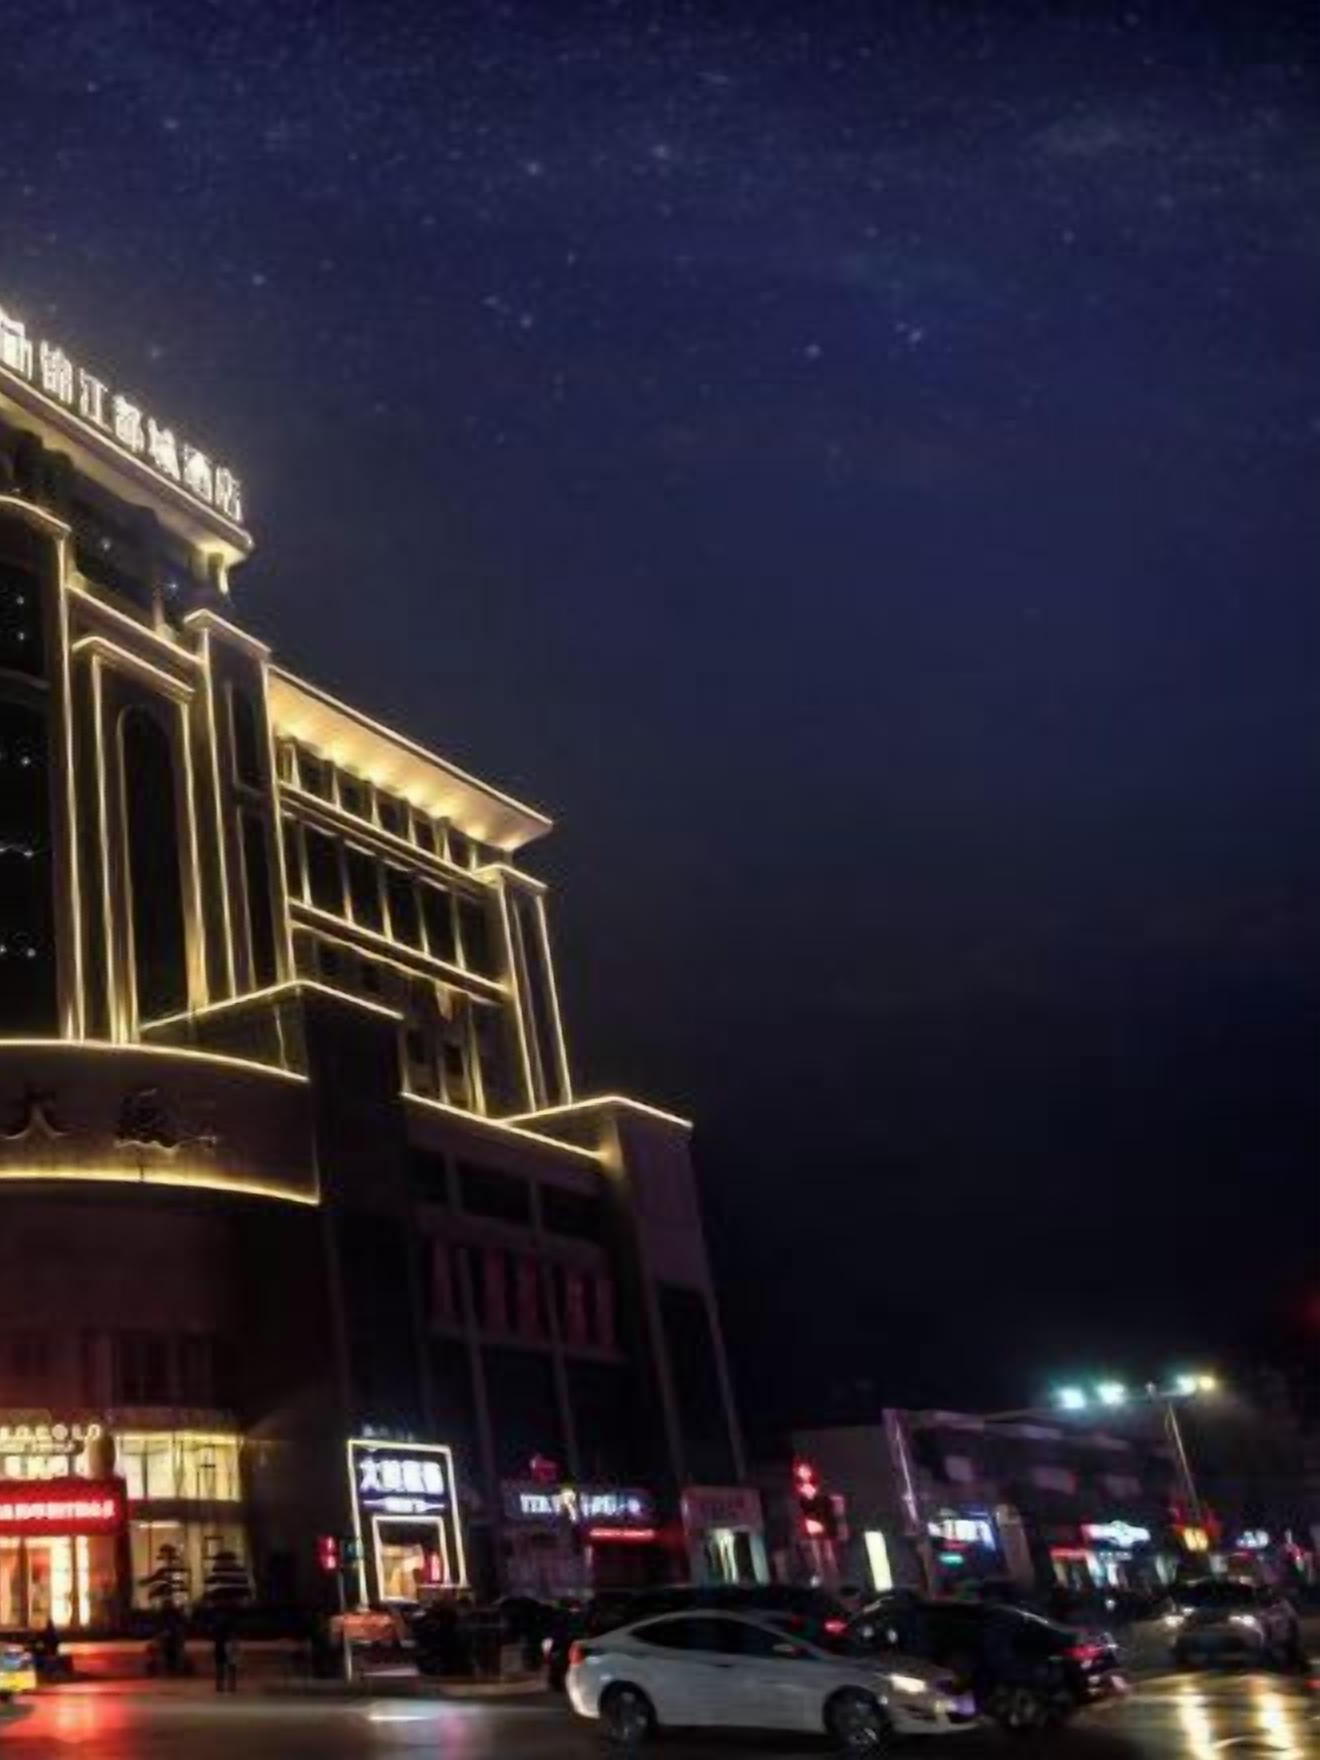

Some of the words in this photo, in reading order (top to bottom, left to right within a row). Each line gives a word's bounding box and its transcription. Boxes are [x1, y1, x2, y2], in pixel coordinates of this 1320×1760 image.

[40, 340, 243, 522] 锦江都城酒店
